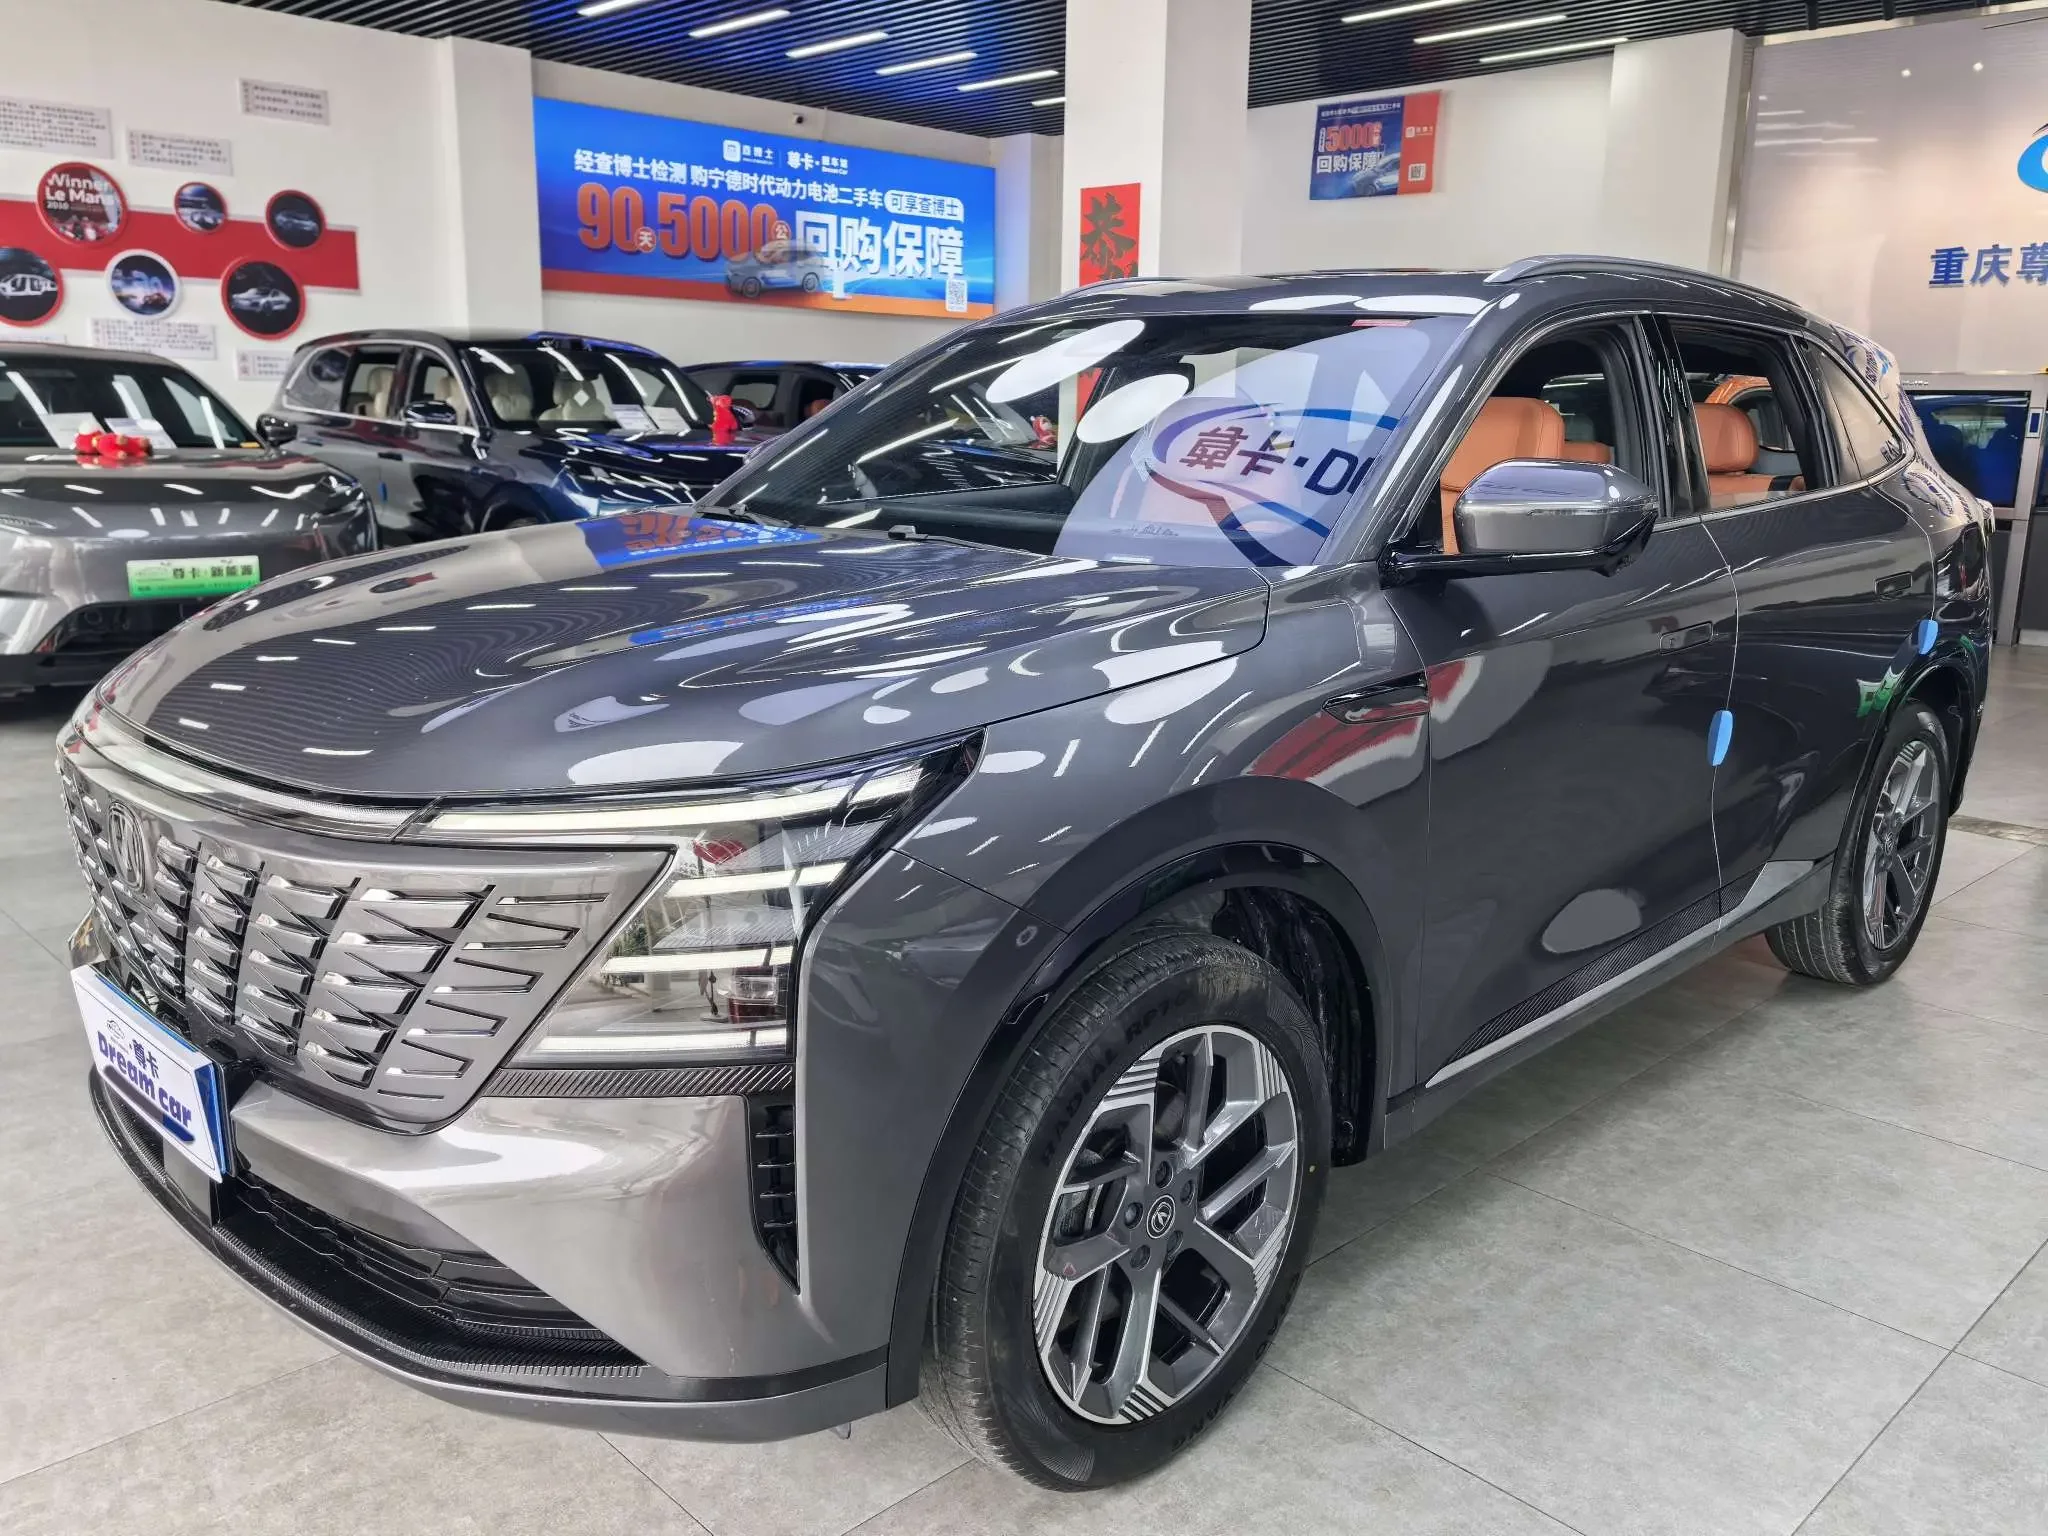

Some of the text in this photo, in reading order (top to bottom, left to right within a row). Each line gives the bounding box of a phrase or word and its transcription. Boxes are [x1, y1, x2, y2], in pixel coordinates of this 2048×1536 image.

[573, 148, 960, 218] 经查博士检测 购宁德时代动力电池二手车 可享查博士
[1316, 151, 1379, 174] 回购保障
[45, 185, 66, 202] Le
[796, 211, 964, 280] 回购保障
[1929, 242, 2048, 286] 重庆尊
[97, 1030, 192, 1128] Dream car
[132, 1039, 160, 1080] 尊卡
